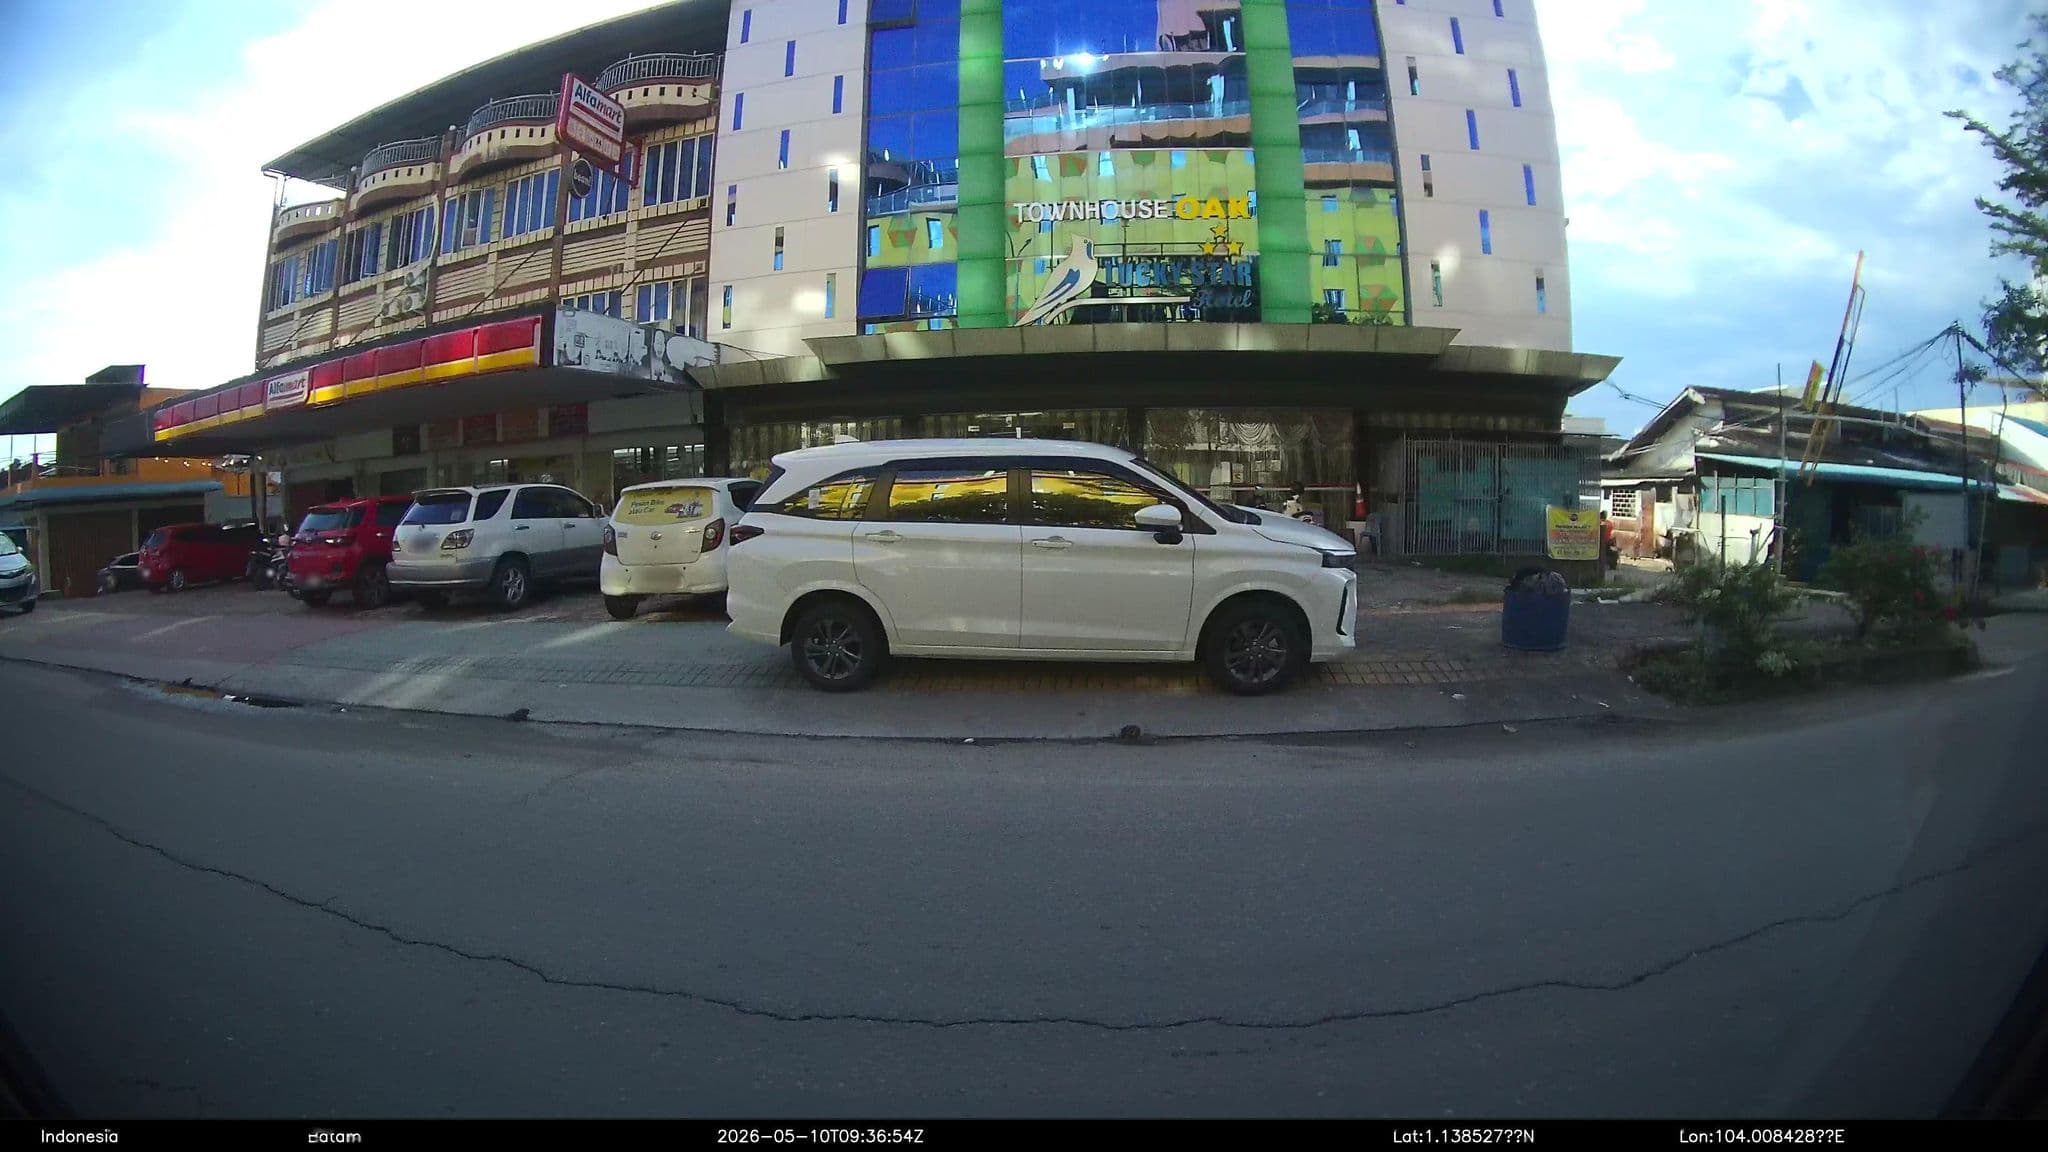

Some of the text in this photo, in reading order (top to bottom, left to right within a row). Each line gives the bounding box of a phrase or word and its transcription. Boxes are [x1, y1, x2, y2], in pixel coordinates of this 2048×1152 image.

[574, 83, 623, 124] Alfamart
[1013, 195, 1250, 223] TOWNHOUSE OAK
[1104, 259, 1253, 288] LUCKY STAR
[1192, 289, 1253, 308] Hotel
[268, 376, 306, 396] Alfamart
